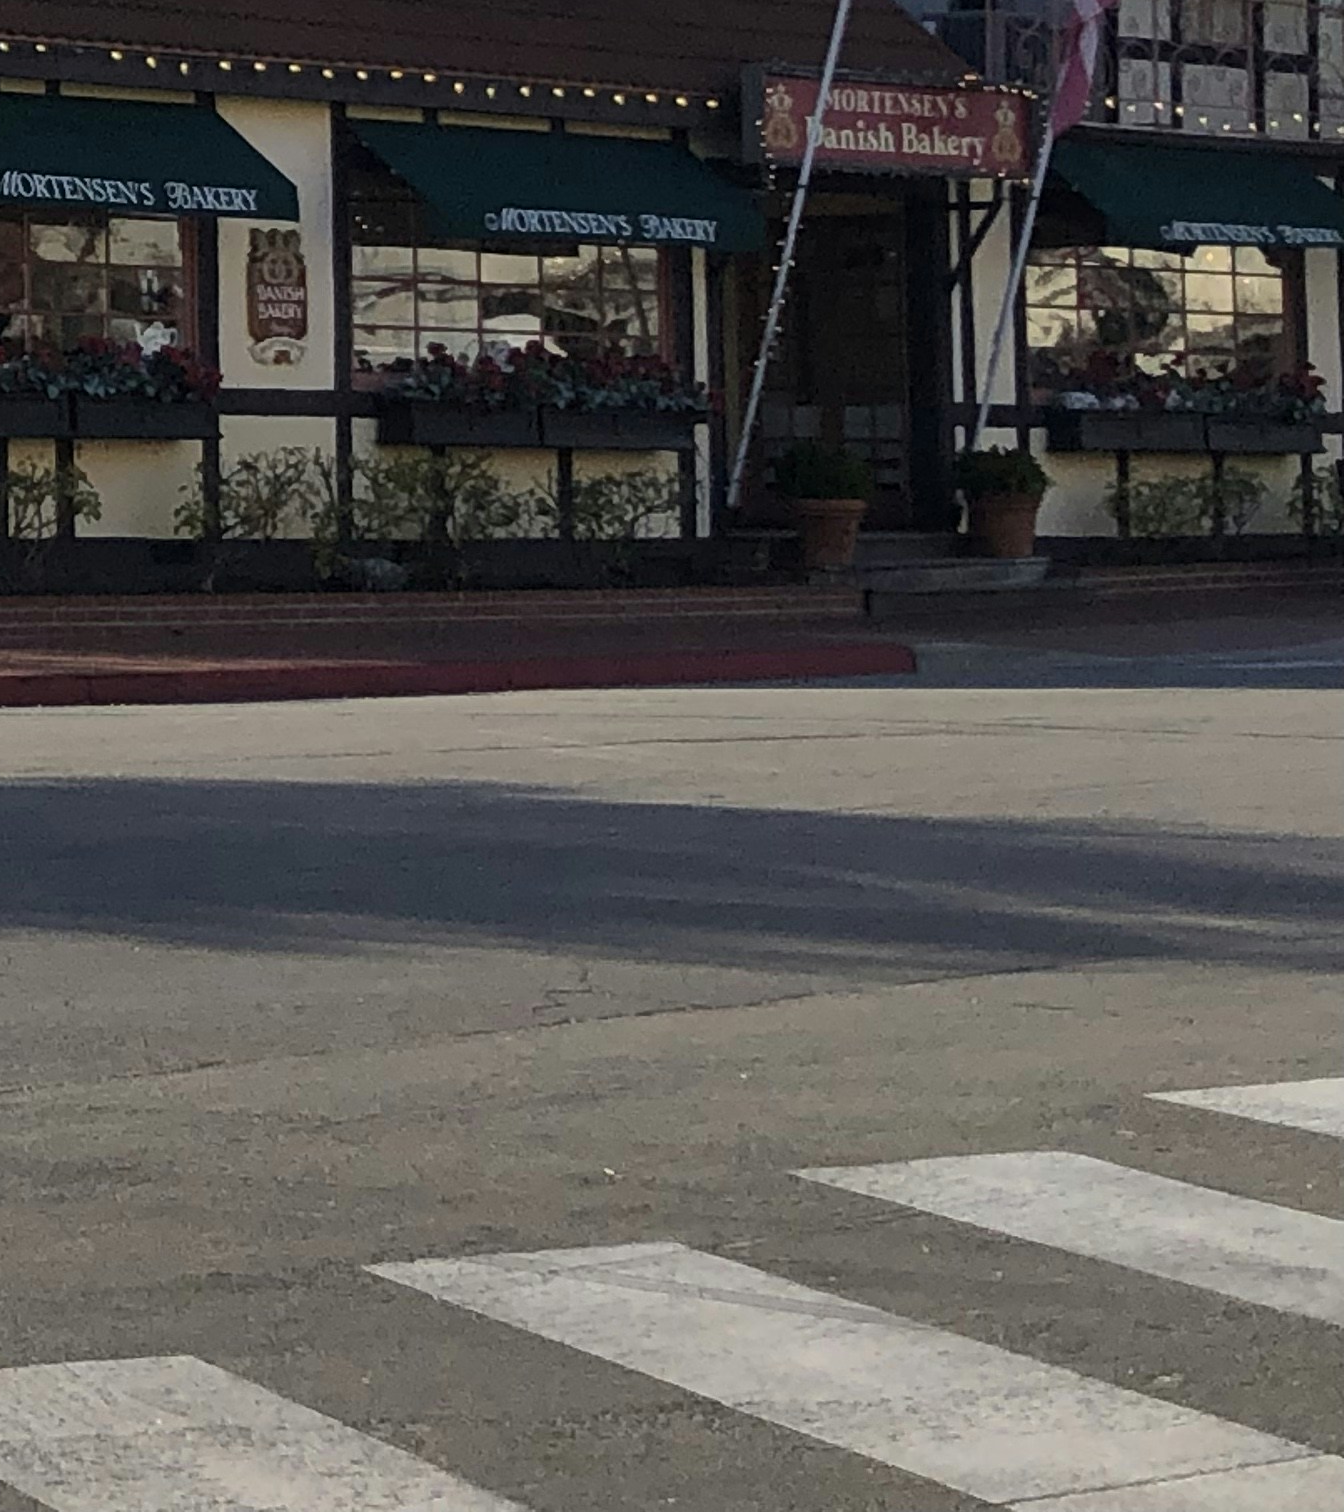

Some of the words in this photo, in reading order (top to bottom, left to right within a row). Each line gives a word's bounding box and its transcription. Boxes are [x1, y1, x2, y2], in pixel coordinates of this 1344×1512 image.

[901, 122, 987, 166] Bakery
[163, 181, 260, 211] BAKERY
[483, 207, 633, 237] MORTENSEN'S
[638, 213, 718, 243] BAKERY
